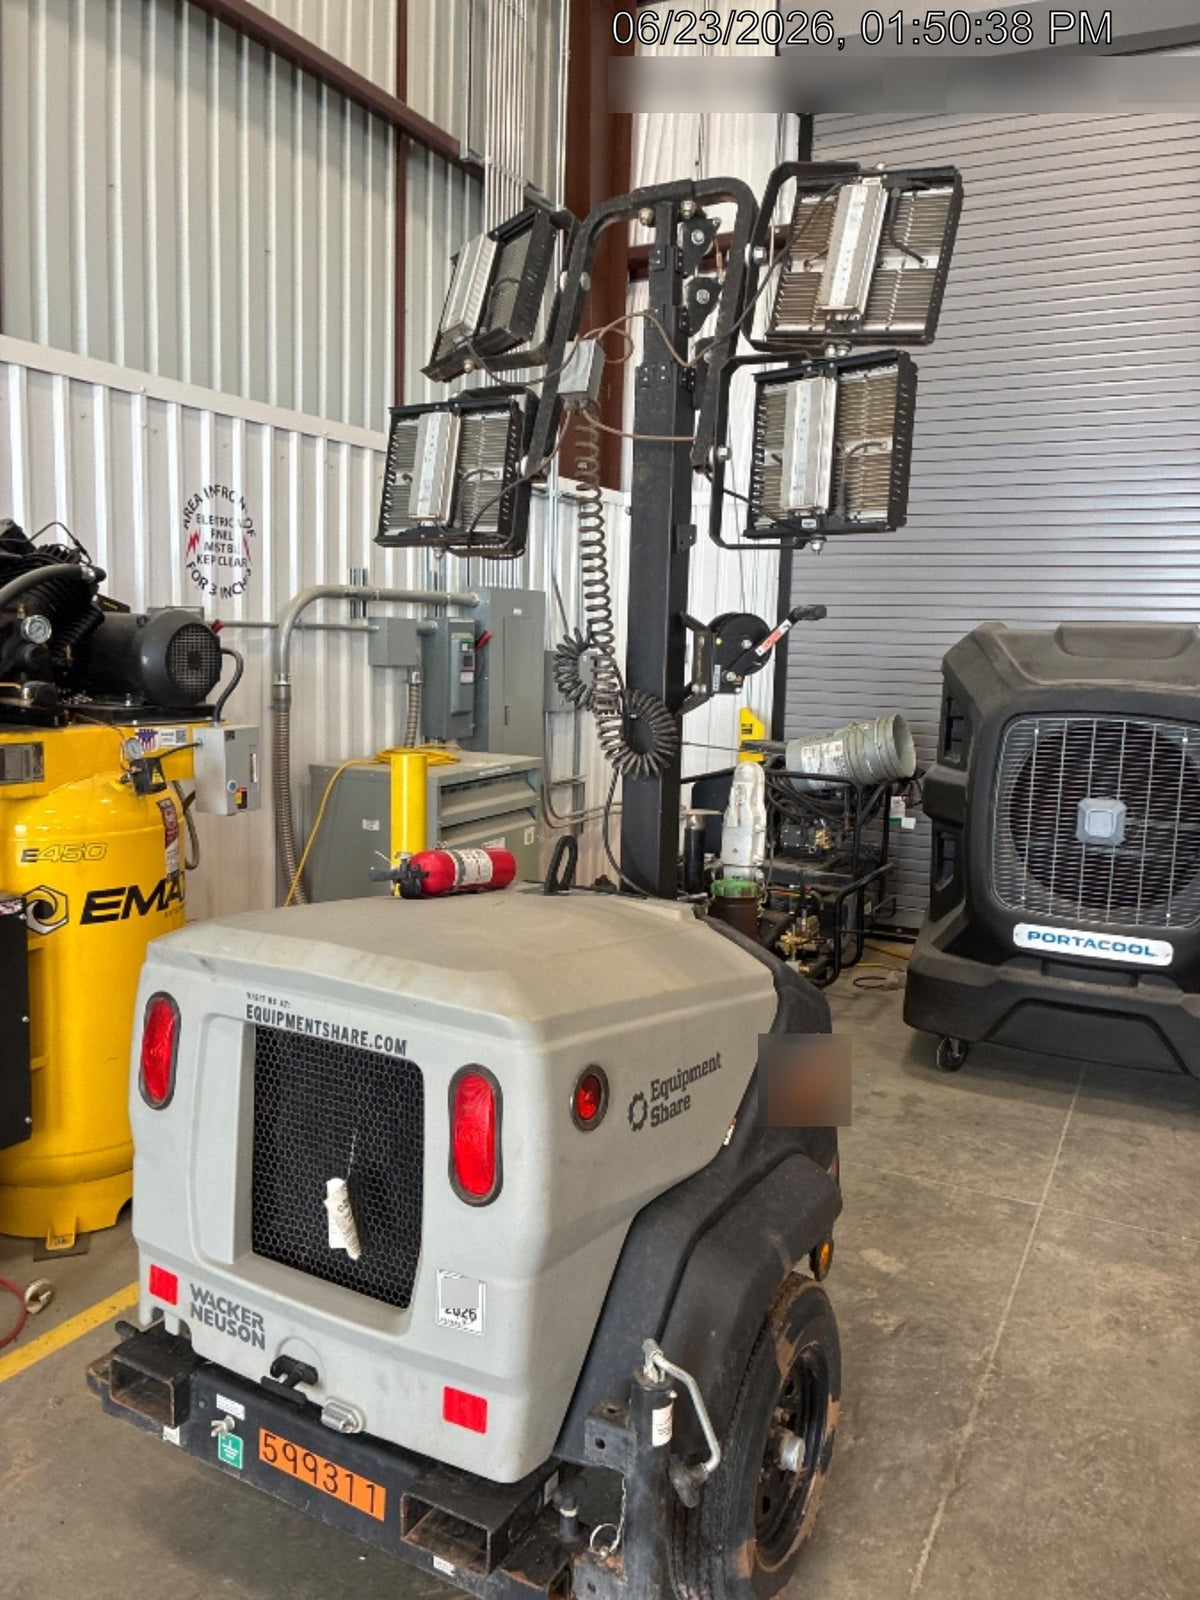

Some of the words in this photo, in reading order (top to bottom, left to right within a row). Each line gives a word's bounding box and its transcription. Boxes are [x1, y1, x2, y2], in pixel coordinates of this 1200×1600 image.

[183, 493, 204, 531] AREA
[20, 841, 109, 864] E450
[80, 870, 186, 925] EMA
[1027, 930, 1159, 958] PORTACOOL
[246, 1003, 408, 1057] EQUIPMENTSHARE.COM
[650, 1050, 723, 1103] Equipment
[650, 1093, 691, 1128] Share
[189, 1283, 265, 1333] WACKER
[190, 1301, 266, 1351] NEUSON
[262, 1432, 377, 1514] 599311
